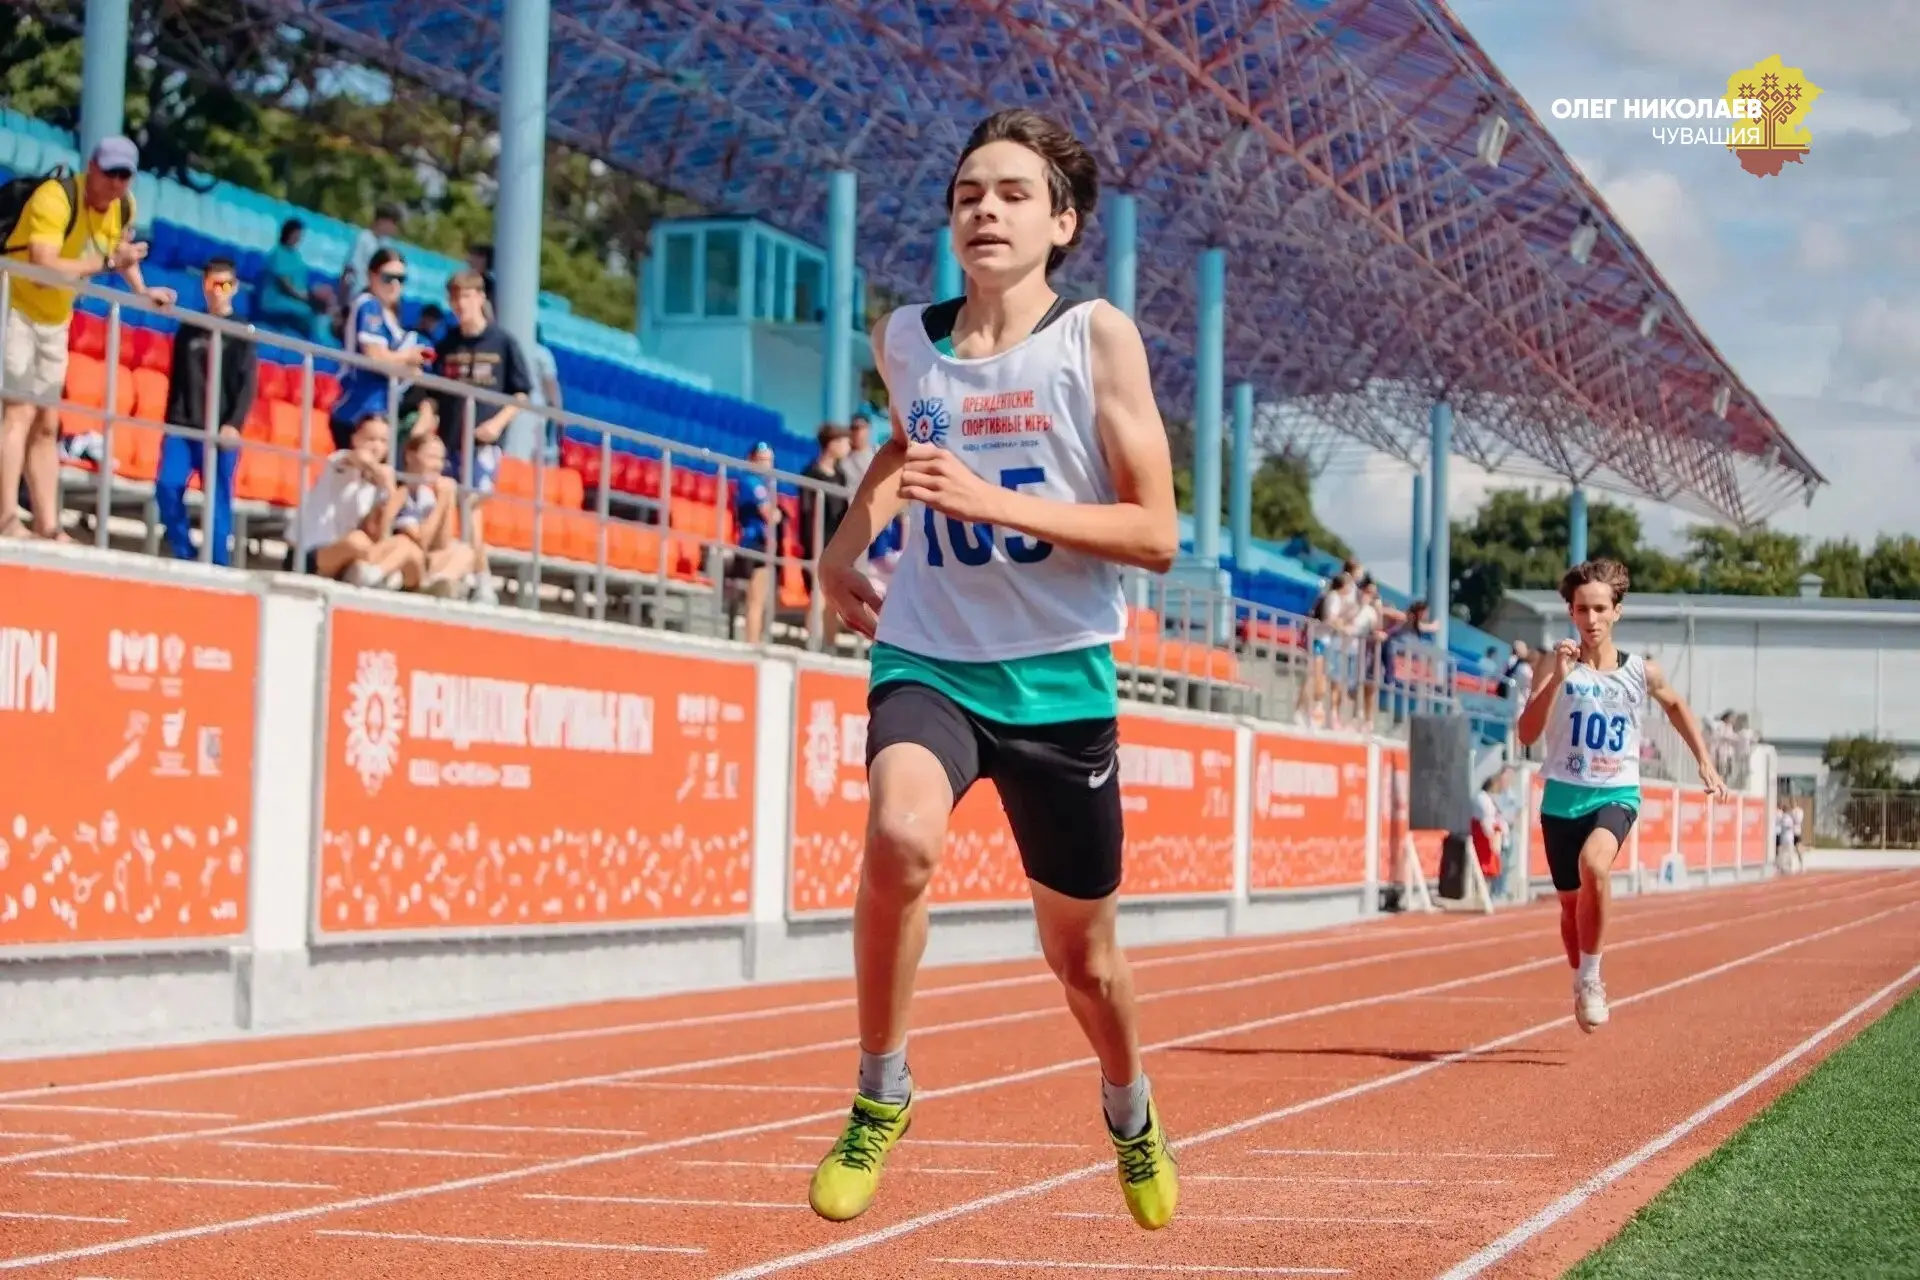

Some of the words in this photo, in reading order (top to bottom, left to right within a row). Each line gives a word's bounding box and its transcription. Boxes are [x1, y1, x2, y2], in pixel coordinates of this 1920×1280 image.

[962, 390, 1034, 412] ПРЕЗИДЕНТСКИЕ
[962, 415, 1023, 436] СПОРТИВНЫЕ
[1025, 413, 1053, 433] ИГРЫ
[1569, 711, 1627, 752] 103
